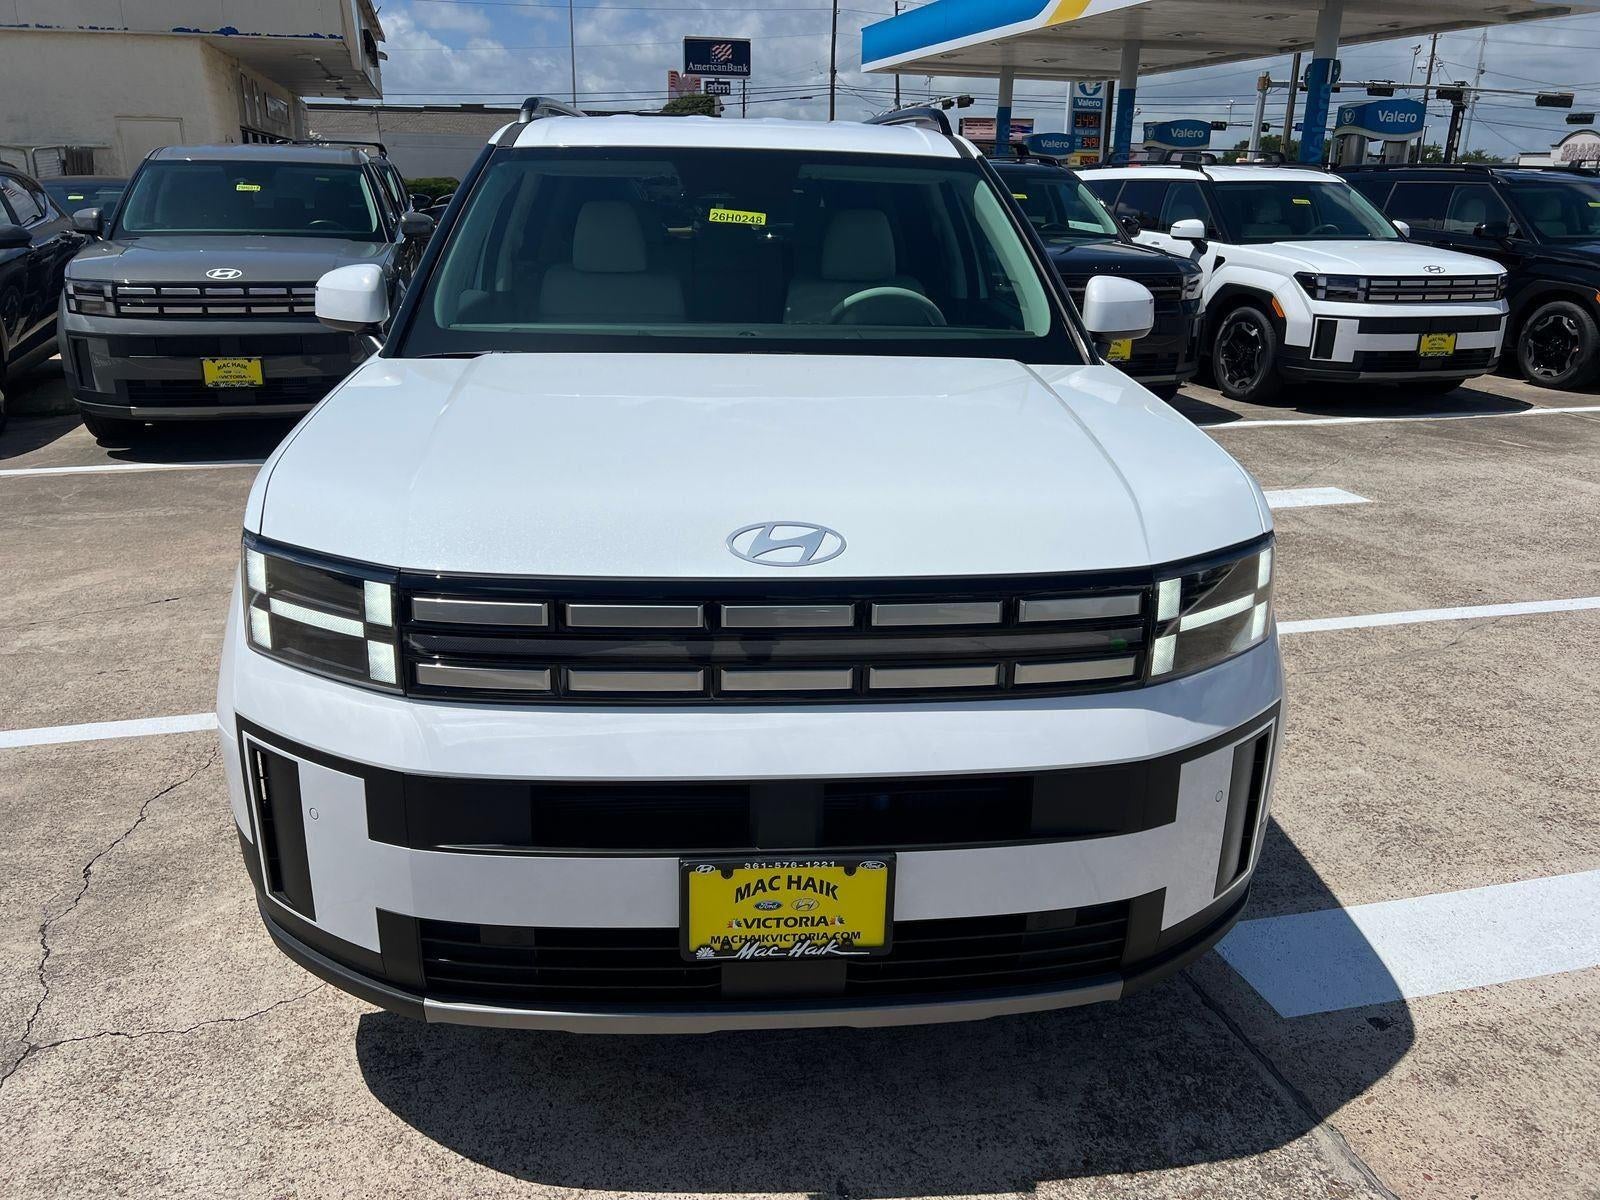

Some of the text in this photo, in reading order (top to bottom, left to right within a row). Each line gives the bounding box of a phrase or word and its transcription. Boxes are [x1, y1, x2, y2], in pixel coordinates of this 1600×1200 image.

[707, 83, 730, 93] atm
[1078, 99, 1101, 107] Valero
[1378, 110, 1417, 123] Valero
[1171, 128, 1204, 138] Valero
[1041, 139, 1070, 148] Valero
[711, 212, 762, 223] 26H0248
[744, 861, 836, 869] 361-576-1221
[734, 875, 839, 903] MAC HAIK
[758, 902, 779, 910] Ford
[742, 915, 830, 929] VICTORIA
[710, 931, 861, 945] MACHAIKVICTORIA.COM
[735, 939, 847, 959] Mac Haik
